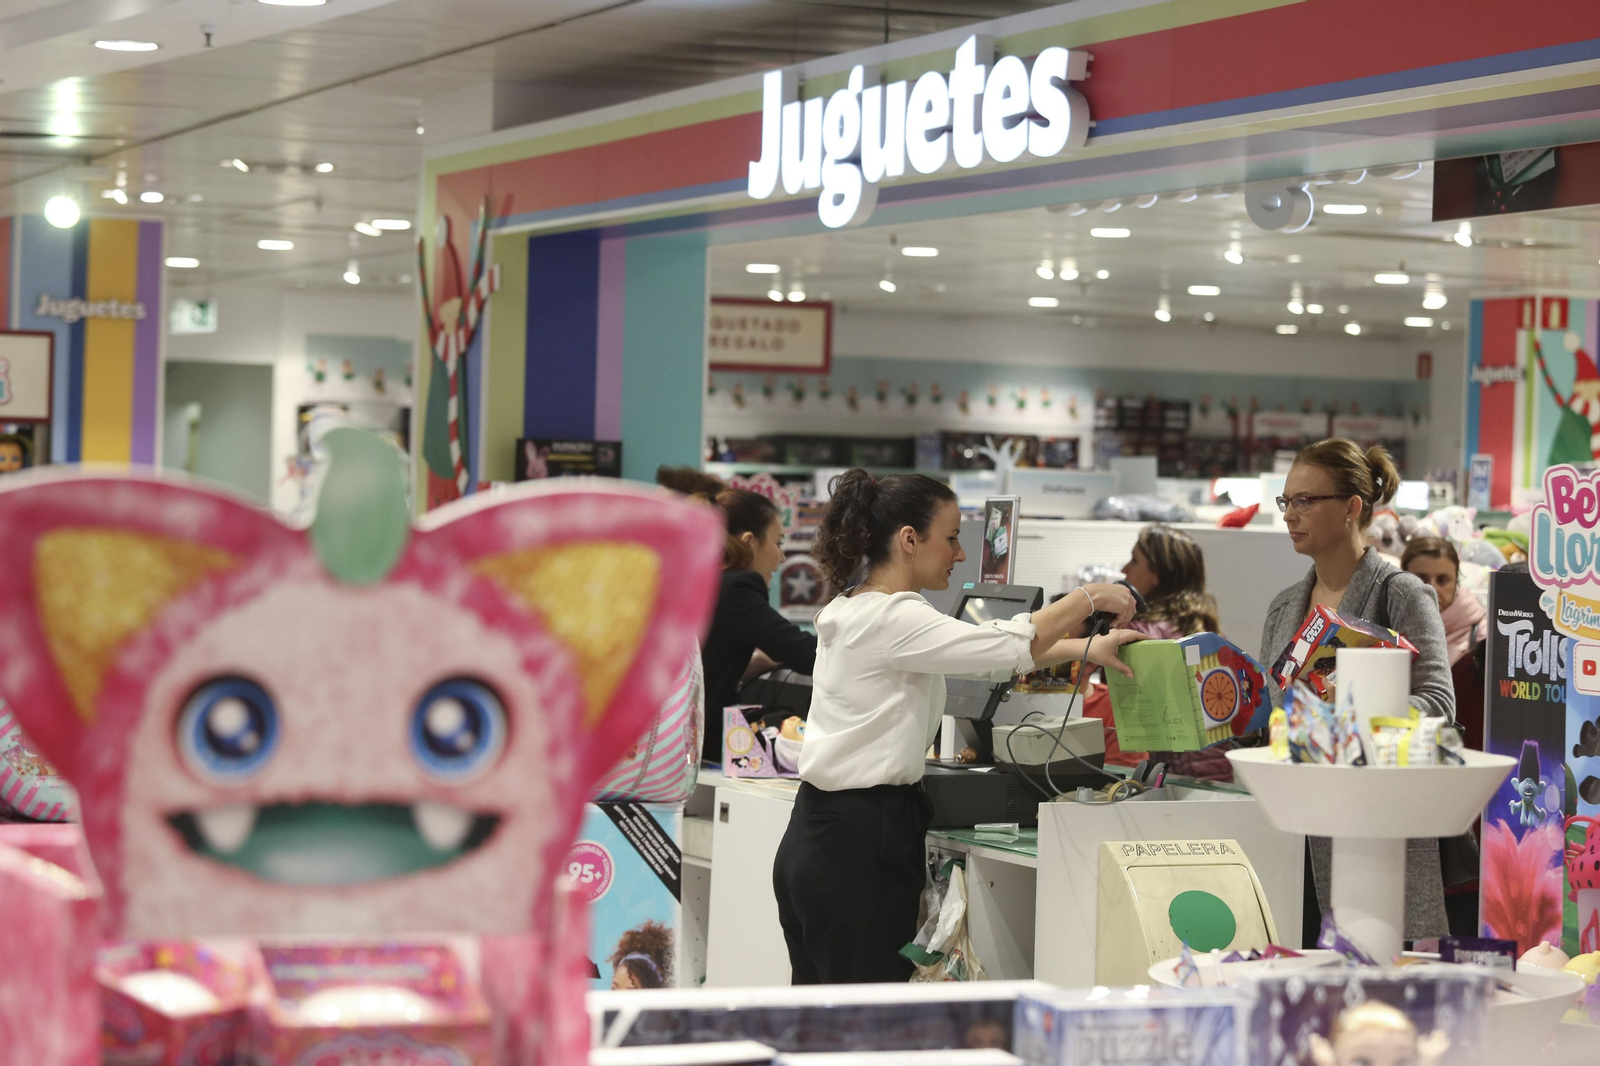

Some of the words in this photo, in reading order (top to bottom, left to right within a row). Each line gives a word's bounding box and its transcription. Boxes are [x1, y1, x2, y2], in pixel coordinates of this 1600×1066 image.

[747, 33, 1072, 229] Juguetes
[36, 293, 147, 323] Juguetes
[711, 315, 802, 334] QUETADO
[1551, 474, 1600, 529] Be
[1562, 595, 1600, 628] Lágrim
[1497, 619, 1567, 682] Trolls
[1499, 680, 1541, 701] WORLD
[1545, 683, 1567, 703] TOU
[1121, 842, 1236, 857] PAPELERA
[568, 862, 602, 884] 95+
